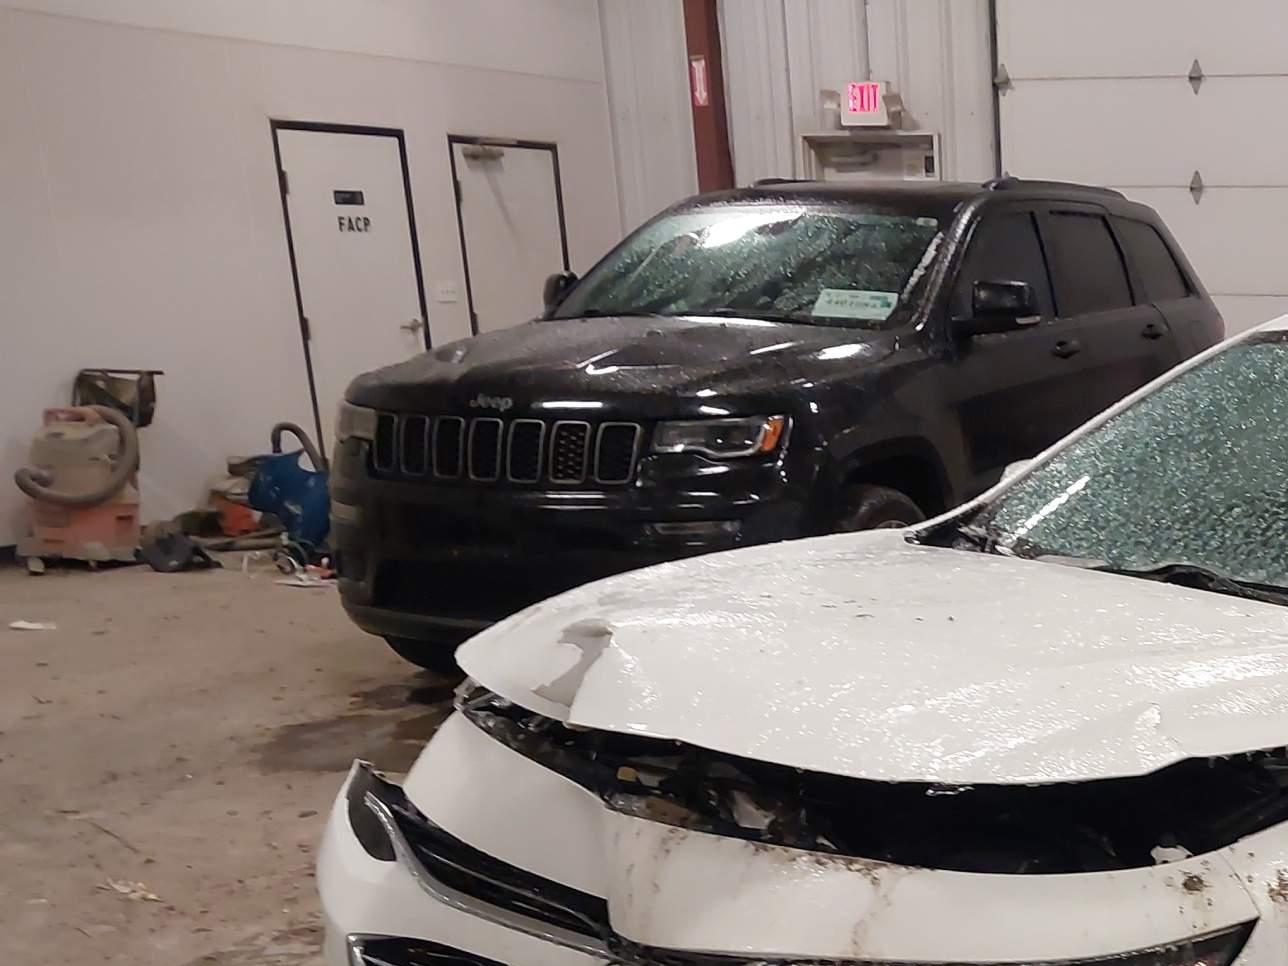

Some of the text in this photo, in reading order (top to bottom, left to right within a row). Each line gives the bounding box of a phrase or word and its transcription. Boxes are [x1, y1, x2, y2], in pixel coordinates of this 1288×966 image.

[848, 84, 879, 112] EXIT
[337, 215, 370, 232] FACP
[469, 393, 513, 412] Jeep
